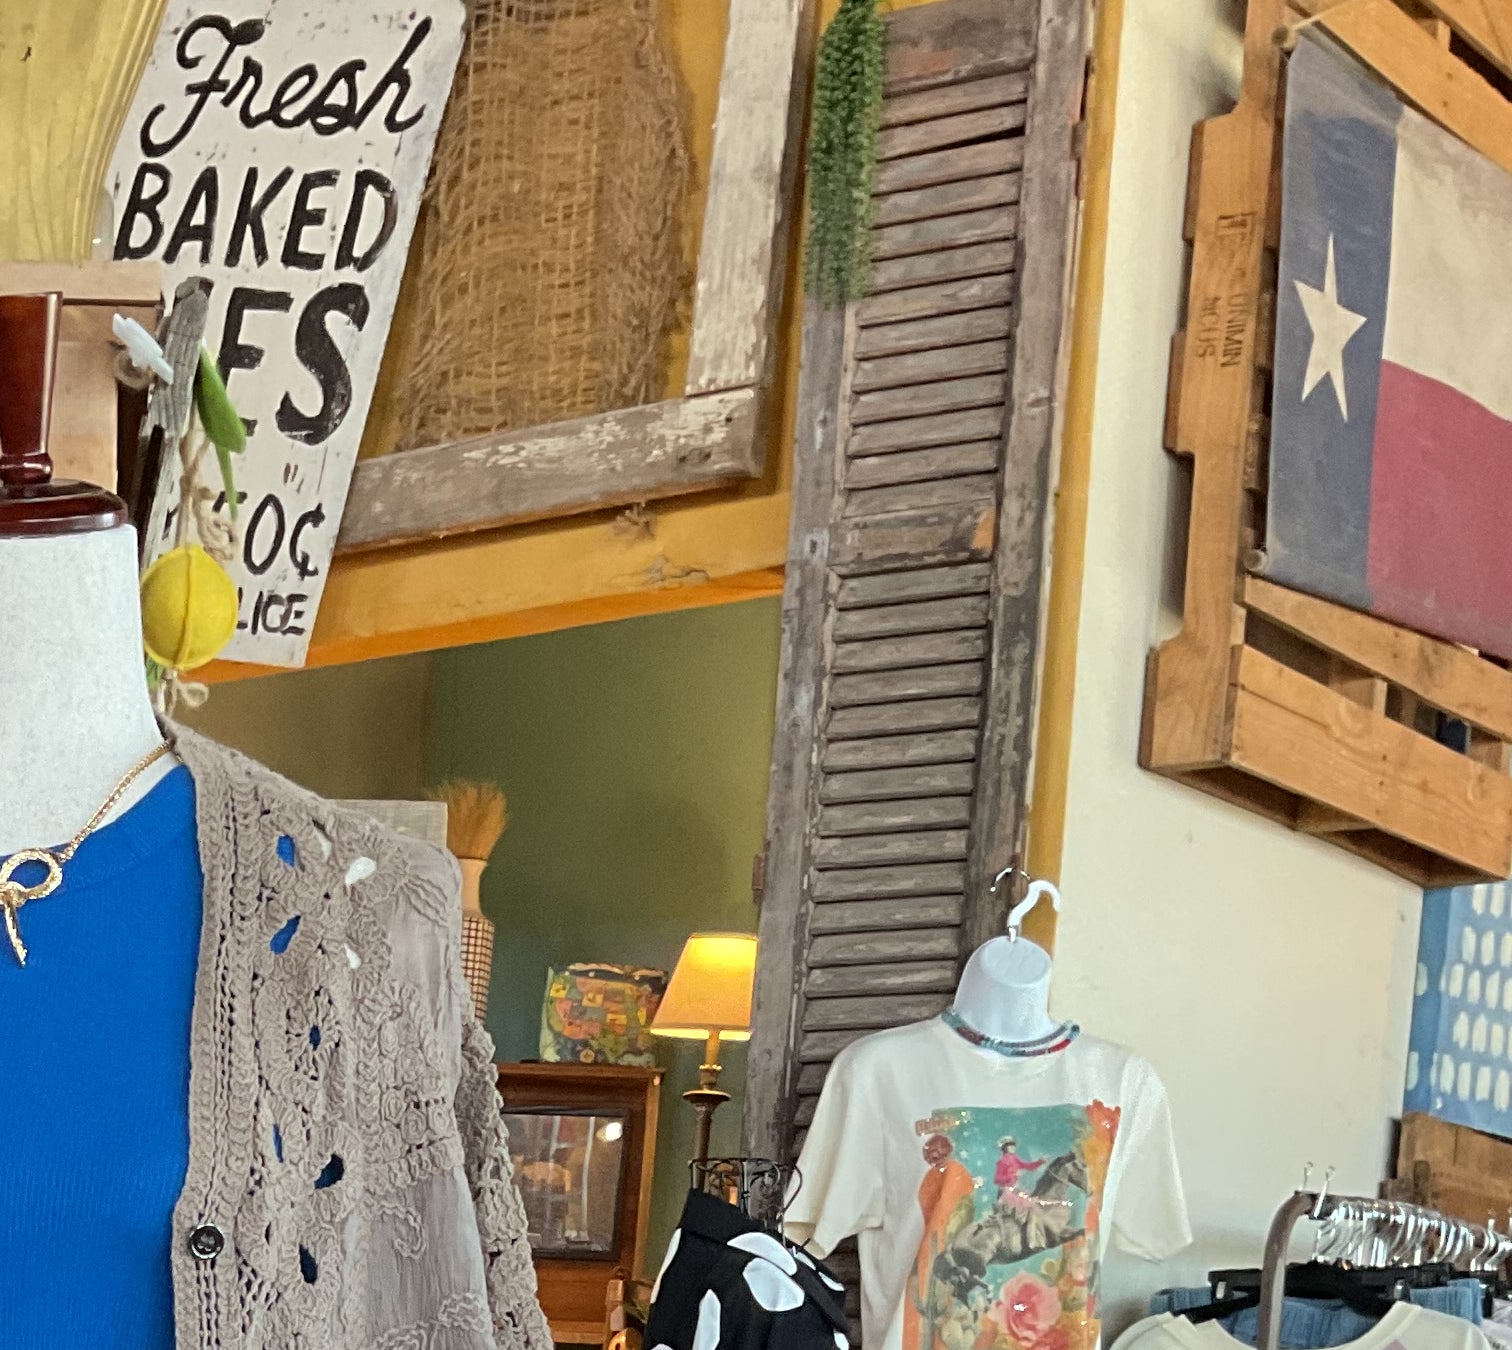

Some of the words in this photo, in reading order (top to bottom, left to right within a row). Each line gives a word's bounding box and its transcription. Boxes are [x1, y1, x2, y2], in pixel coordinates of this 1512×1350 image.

[139, 14, 432, 158] Fresh
[113, 162, 398, 272] BAKED
[172, 277, 370, 446] ES
[212, 491, 326, 581] 0¢
[237, 587, 308, 636] LICE
